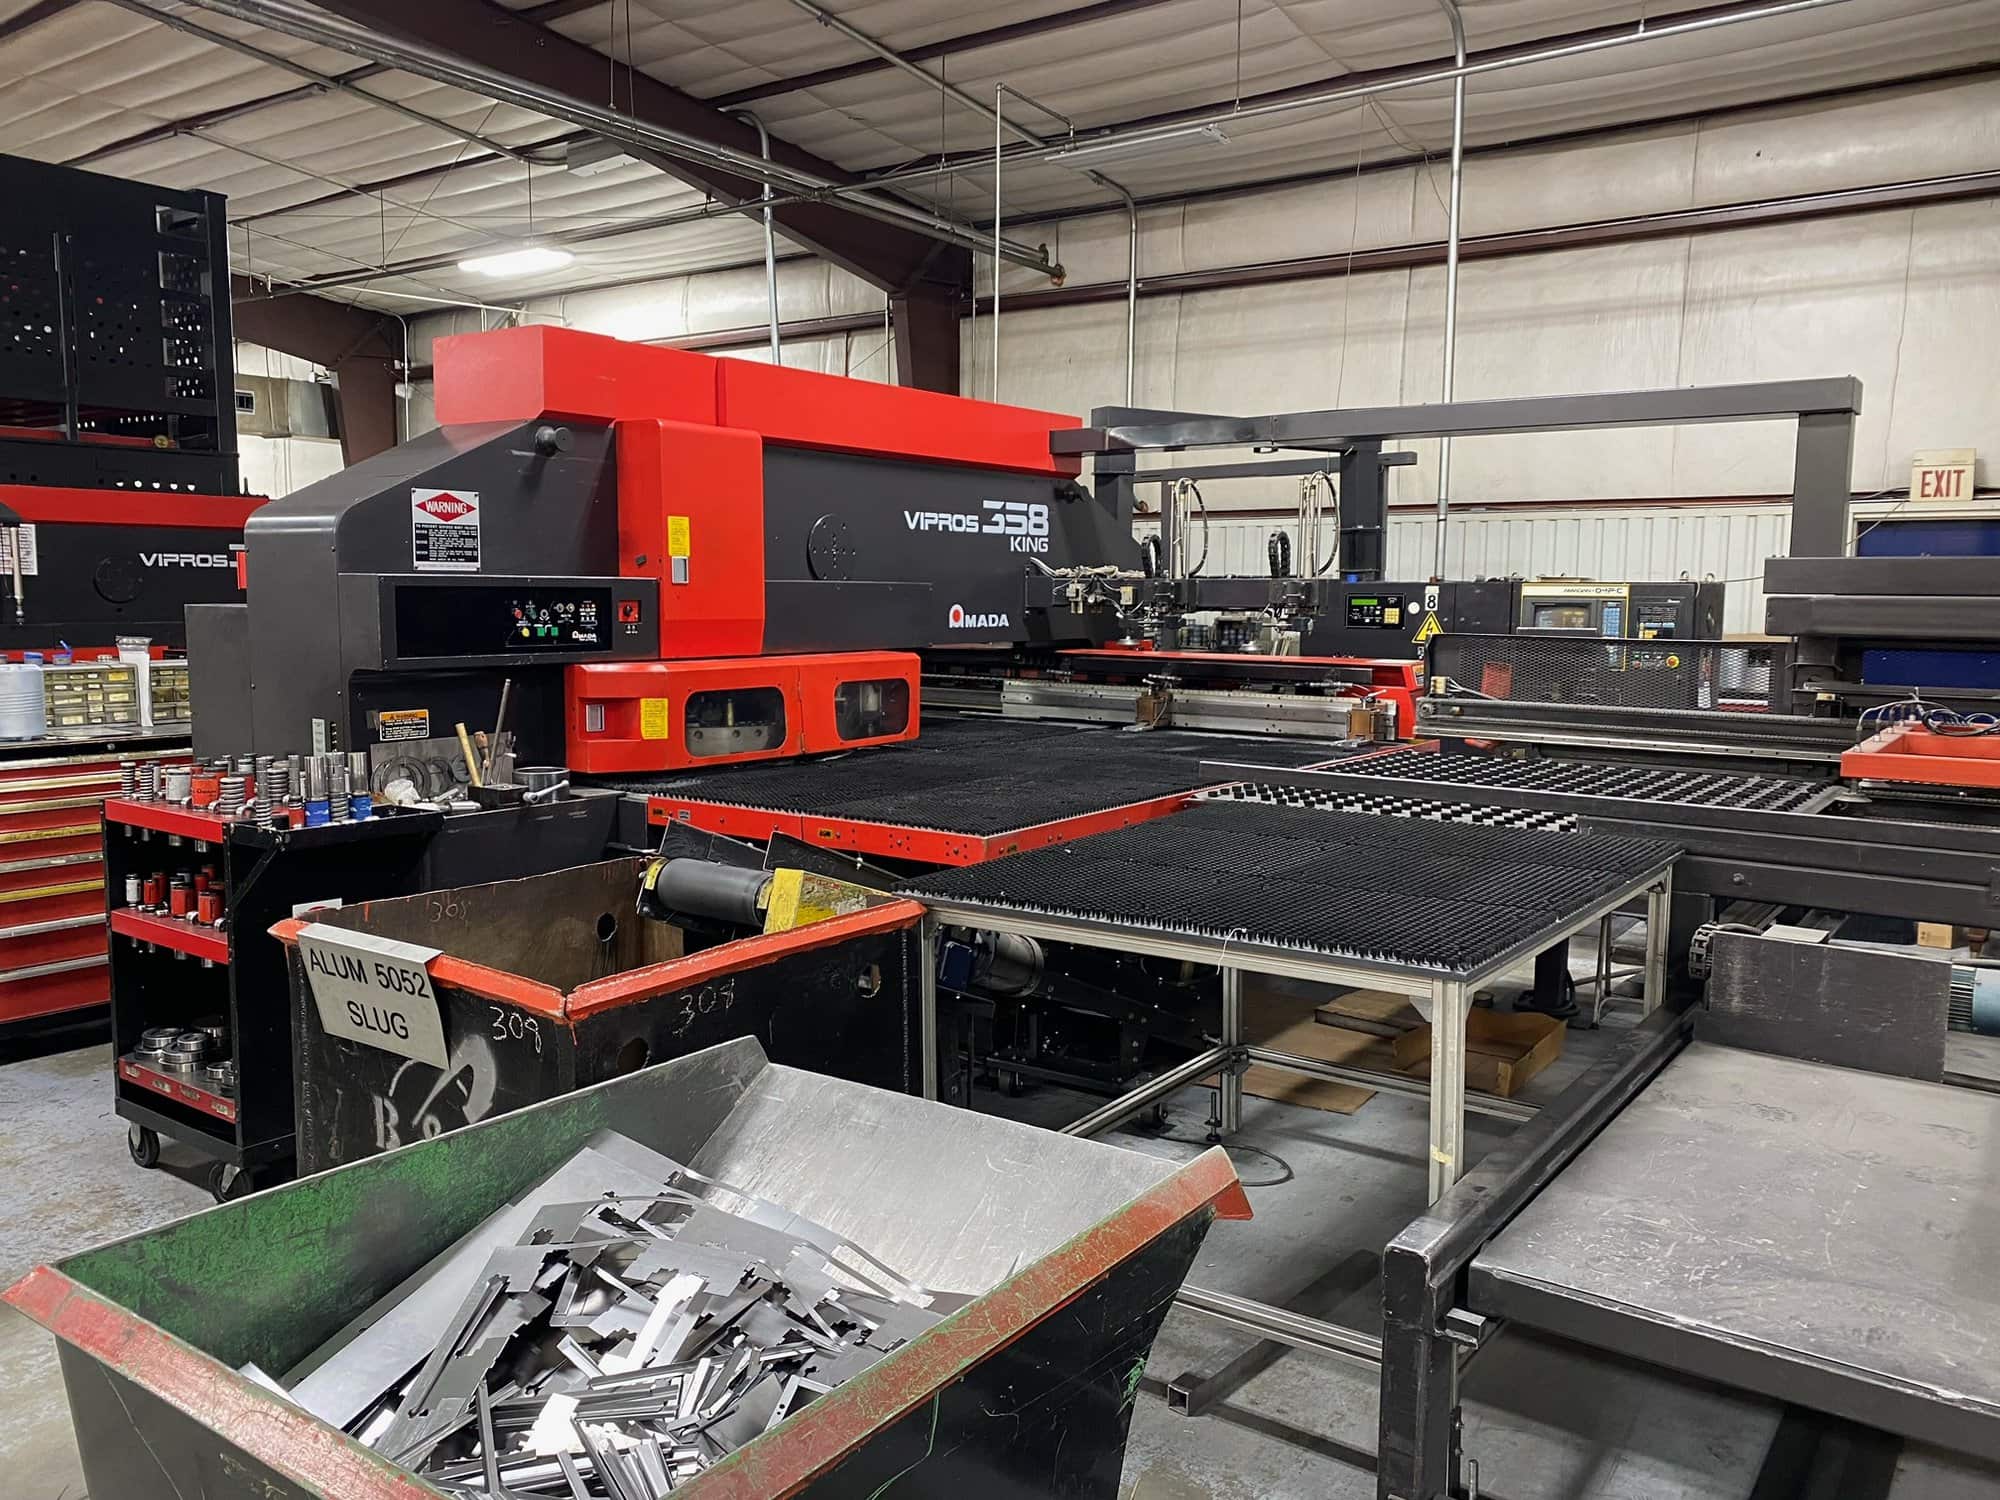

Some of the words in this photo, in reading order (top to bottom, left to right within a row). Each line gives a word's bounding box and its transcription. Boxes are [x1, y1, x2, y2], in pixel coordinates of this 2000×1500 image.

[1920, 469, 1966, 498] EXIT
[425, 500, 468, 514] WARNING
[904, 510, 979, 533] VIPROS
[982, 500, 1049, 536] 358
[1010, 535, 1049, 553] KING
[139, 552, 228, 568] VIPROS
[1426, 594, 1437, 610] 8
[949, 604, 1010, 629] AMADA
[310, 947, 369, 985] ALUM
[374, 962, 431, 1000] 5052
[346, 1000, 409, 1041] SLUG
